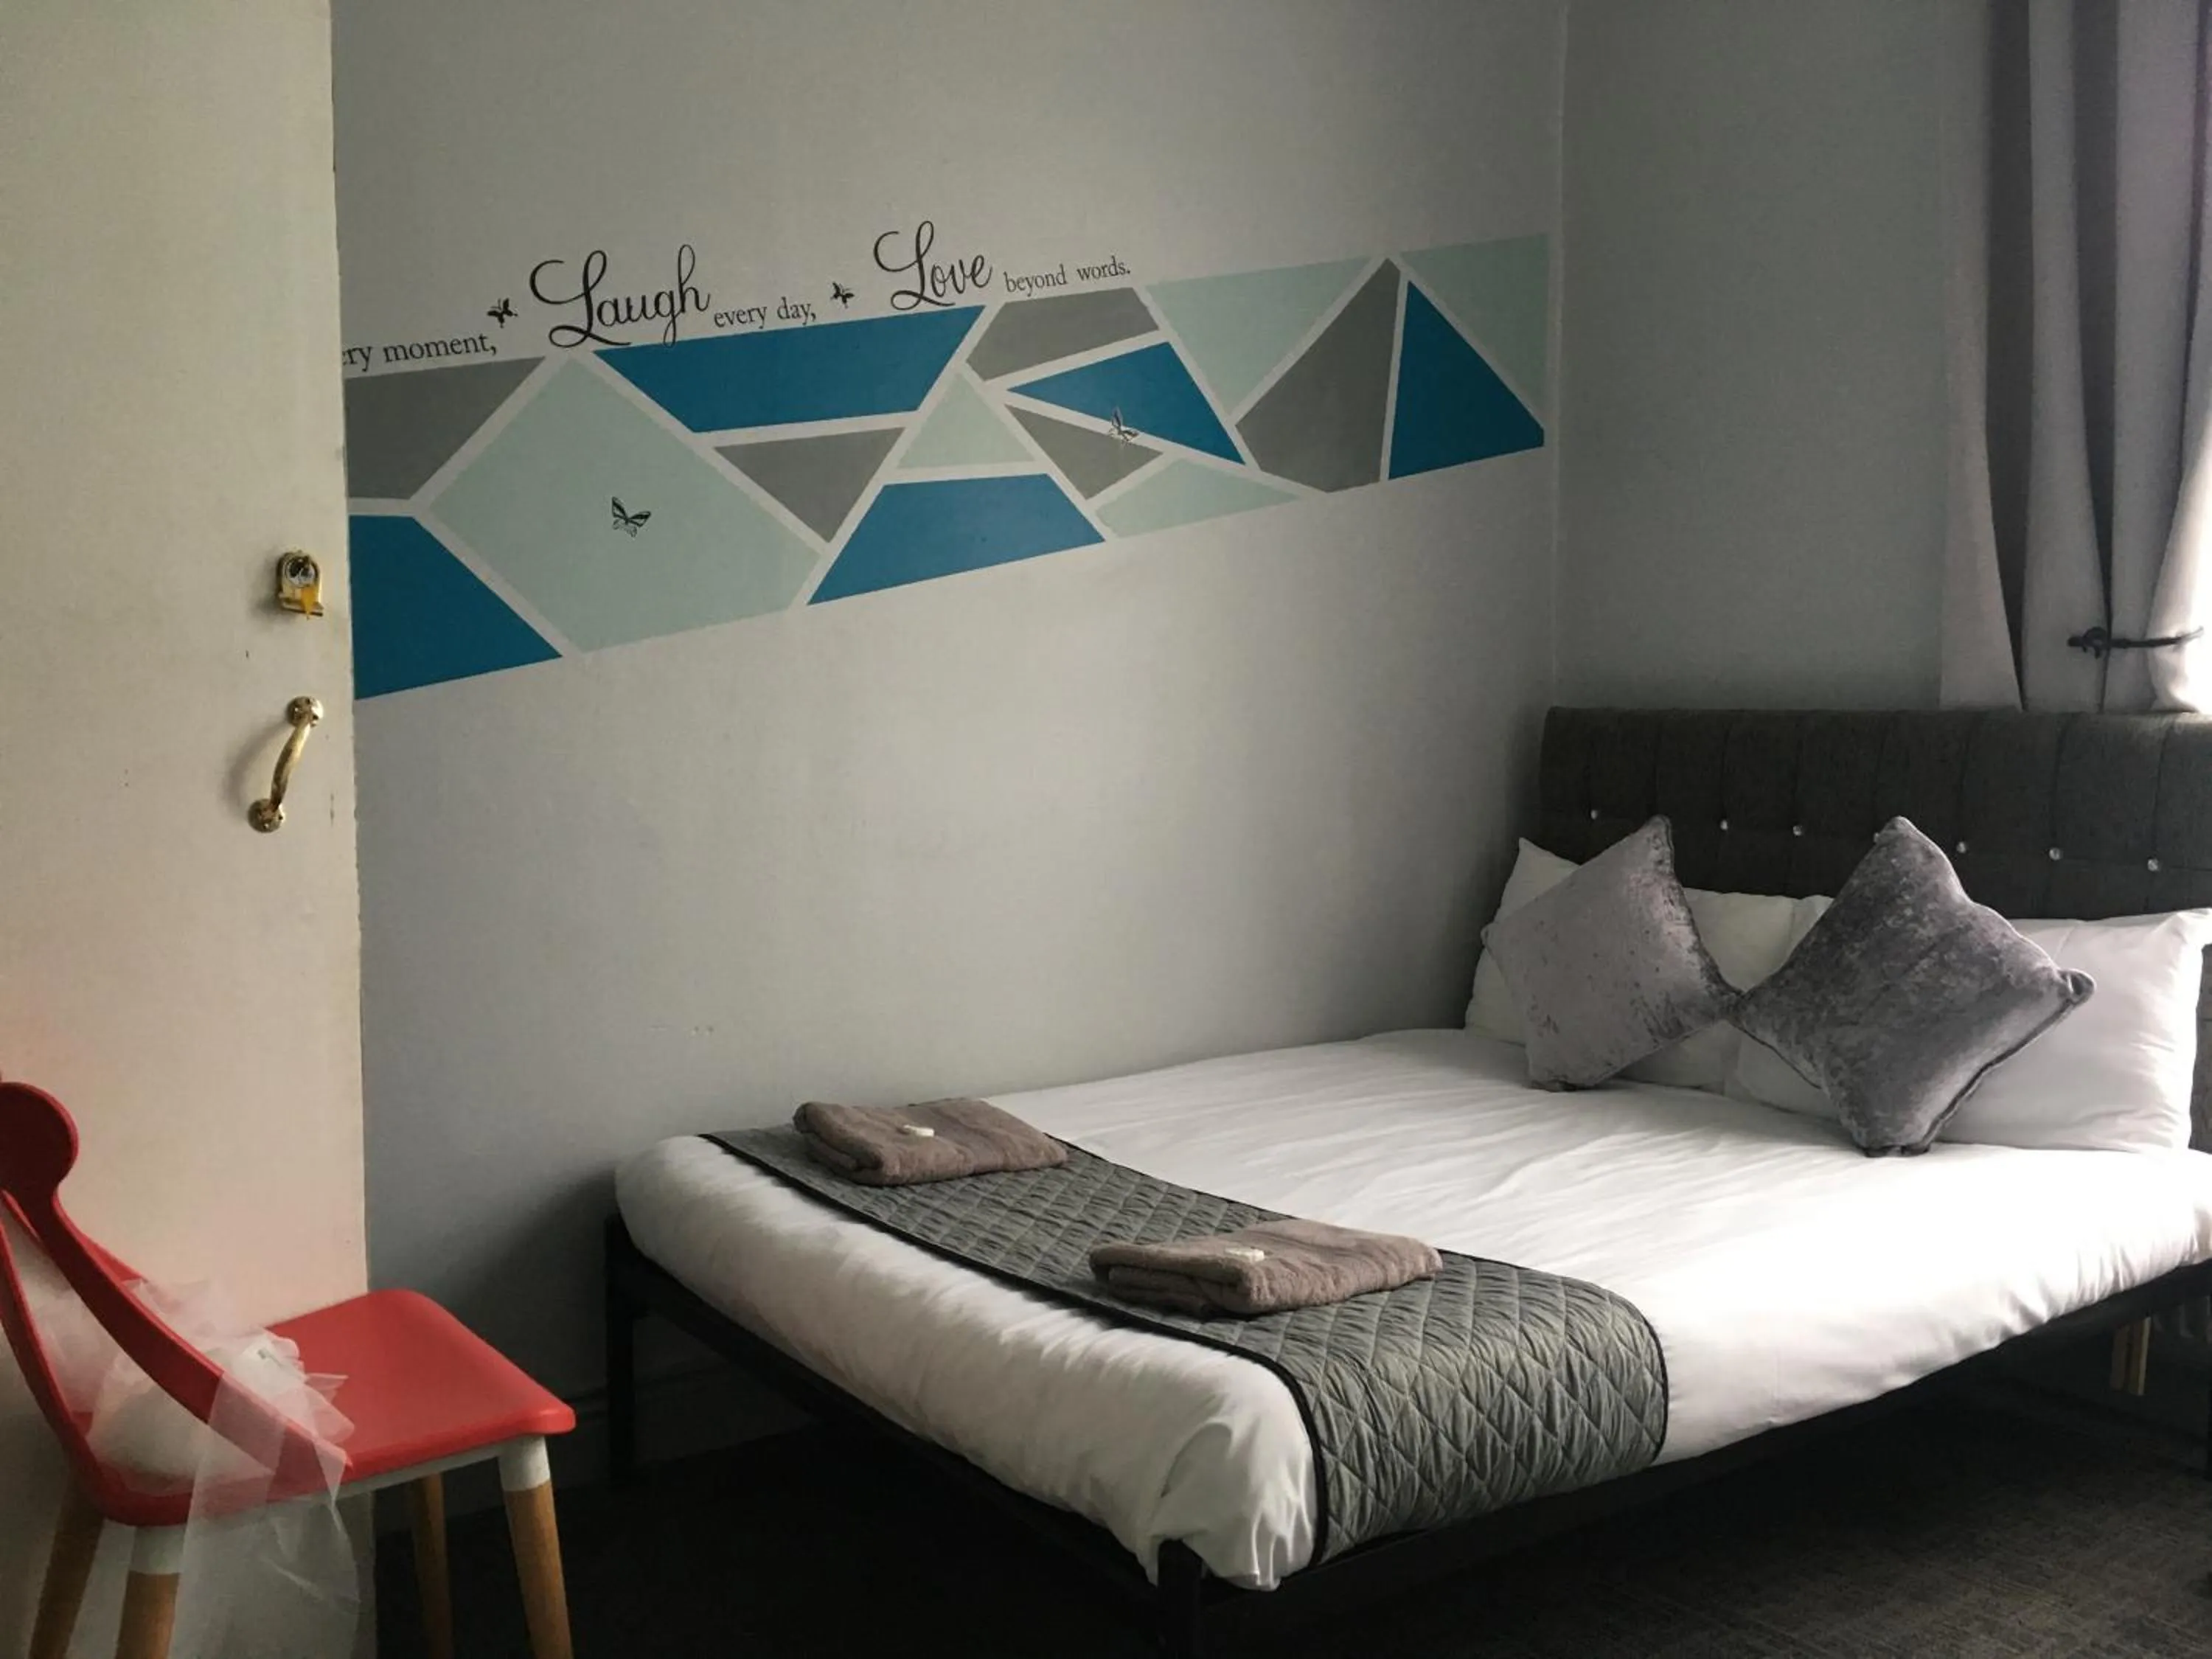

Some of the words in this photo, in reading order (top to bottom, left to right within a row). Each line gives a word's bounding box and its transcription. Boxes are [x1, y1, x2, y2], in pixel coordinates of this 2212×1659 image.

[383, 333, 497, 363] moment,
[529, 244, 710, 349] Laugh
[713, 299, 768, 329] every
[776, 295, 817, 322] day,
[874, 220, 992, 310] Love
[1004, 265, 1068, 298] beyond
[1077, 255, 1131, 279] words.
